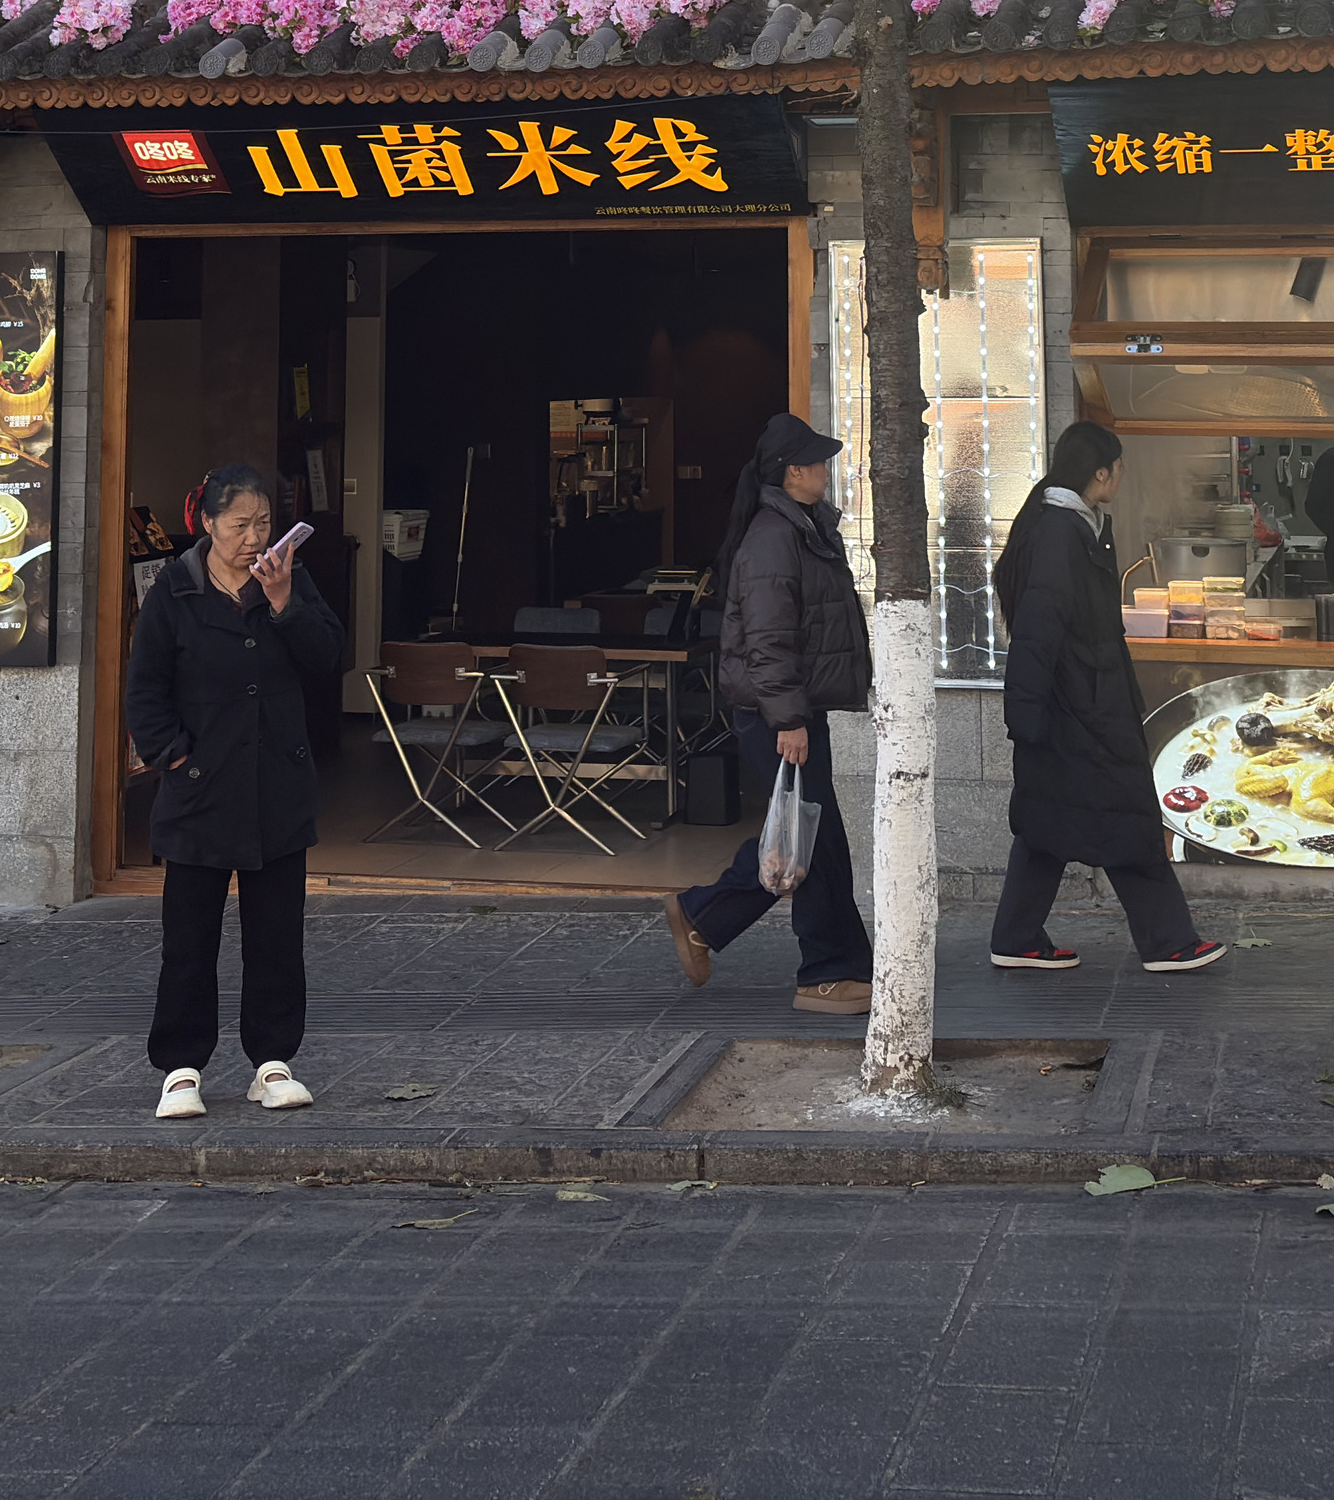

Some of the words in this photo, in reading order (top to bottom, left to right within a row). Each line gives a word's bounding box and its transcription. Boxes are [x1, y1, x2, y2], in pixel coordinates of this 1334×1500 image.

[134, 140, 195, 161] 咚咚
[247, 117, 729, 198] 山菌米线
[594, 203, 792, 216] 云南咚咚餐饮管理有限公司大理分公司
